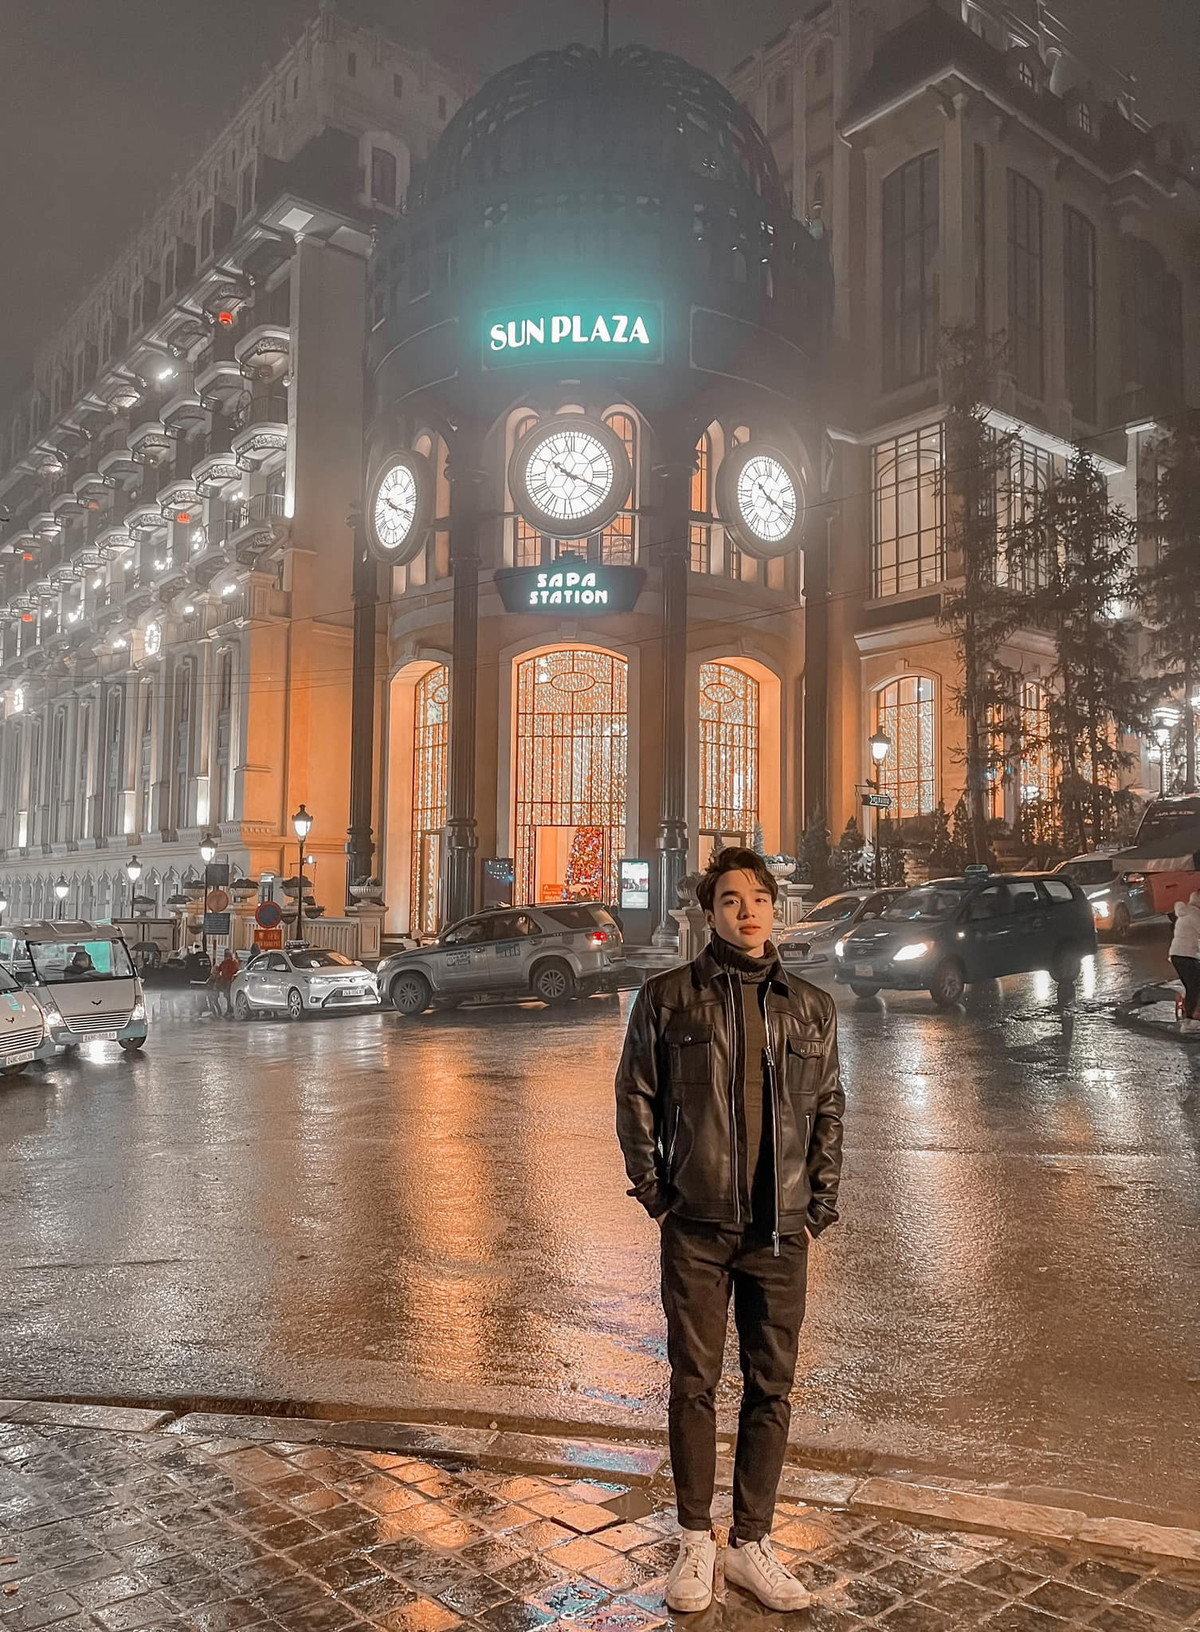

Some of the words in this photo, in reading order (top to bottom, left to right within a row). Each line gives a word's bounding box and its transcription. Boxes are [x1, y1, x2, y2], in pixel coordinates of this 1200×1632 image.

[491, 318, 544, 350] SUN
[552, 316, 649, 343] PLAZA
[538, 573, 595, 587] SAPA
[530, 590, 607, 604] STATION
